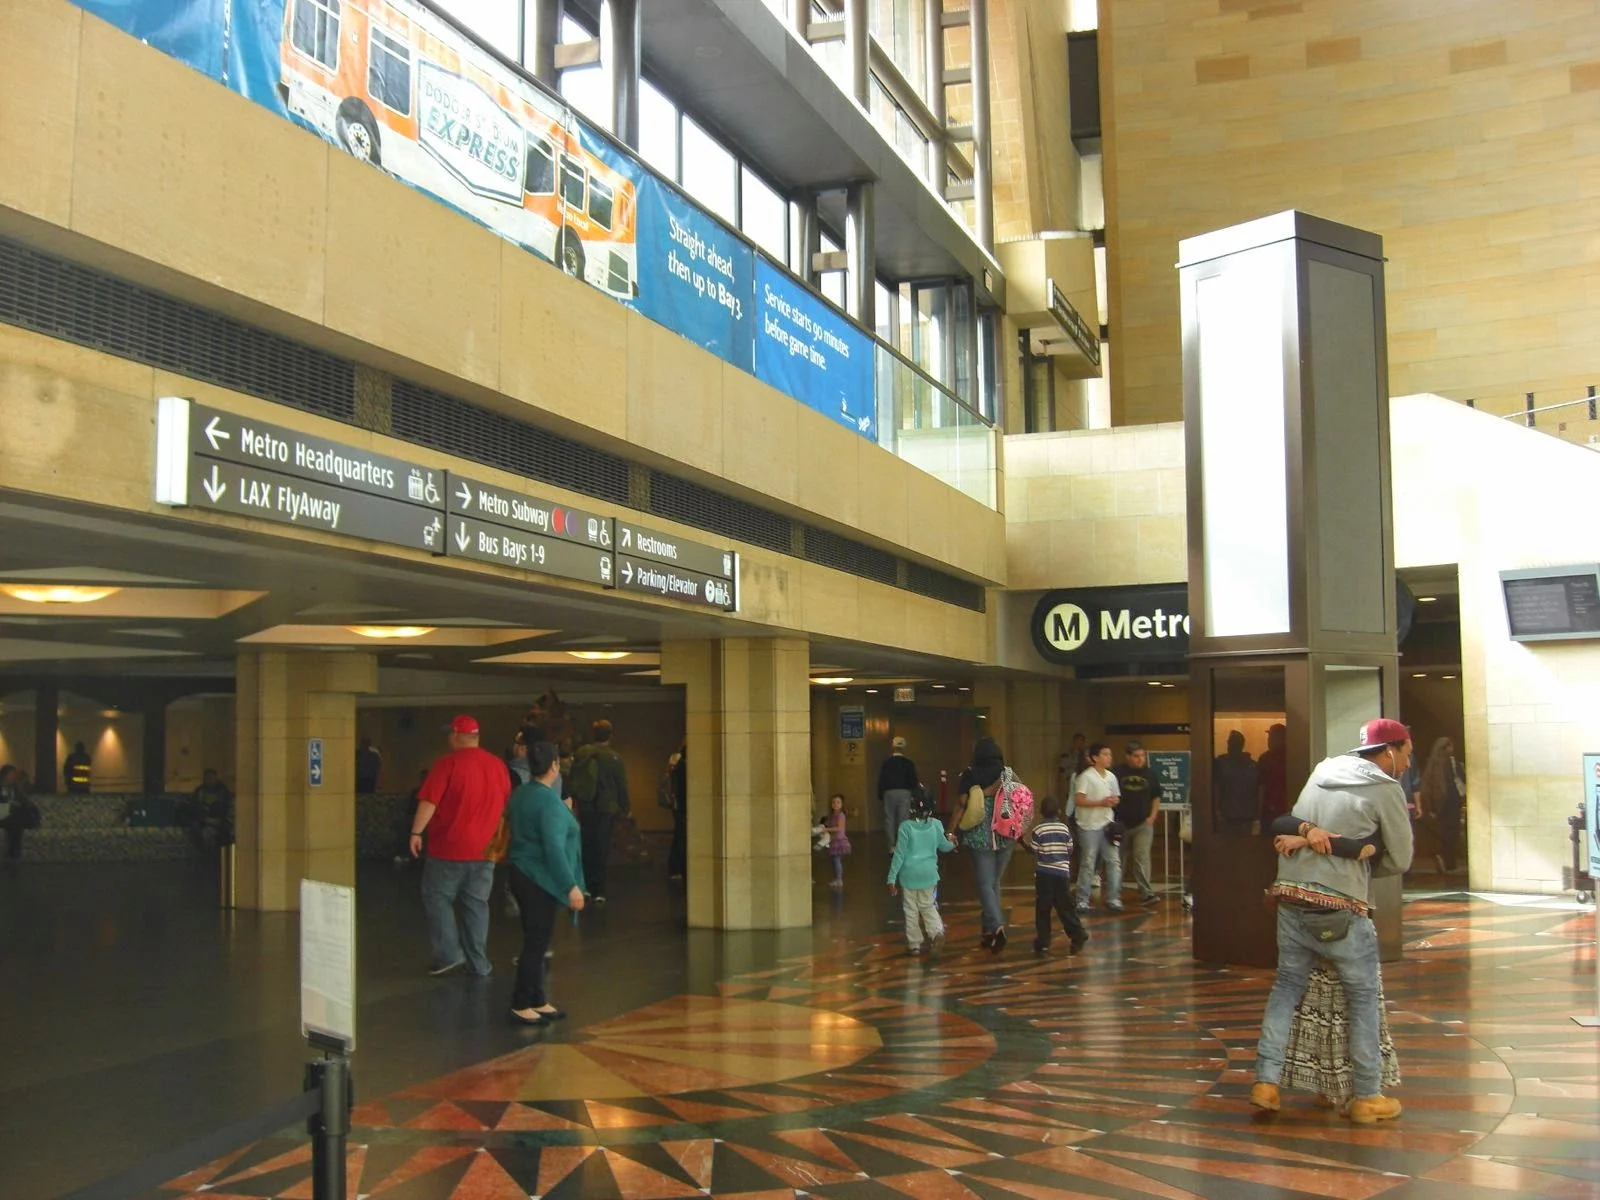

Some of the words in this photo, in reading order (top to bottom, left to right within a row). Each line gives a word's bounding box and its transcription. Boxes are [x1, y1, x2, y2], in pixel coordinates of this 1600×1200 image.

[427, 106, 520, 182] EXPRESS
[669, 215, 706, 261] Straight
[707, 243, 735, 284] ahead,
[668, 249, 691, 283] then
[693, 271, 705, 297] up
[706, 276, 717, 300] to
[718, 281, 735, 317] Bay
[765, 283, 791, 320] Service
[791, 306, 812, 333] starts
[812, 322, 823, 342] 90
[823, 329, 849, 358] minutes
[765, 311, 789, 347] before
[789, 335, 809, 359] game
[809, 344, 827, 371] time.
[241, 427, 288, 463] Metro
[295, 441, 395, 489] Headquarters
[240, 478, 271, 509] LAX
[278, 486, 341, 529] FlyAway
[479, 490, 509, 517] Metro
[512, 499, 549, 532] Subway
[479, 531, 499, 555] Bus
[503, 536, 528, 565] Bays
[530, 543, 545, 565] 1-9
[637, 533, 678, 560] Restrooms
[637, 567, 698, 596] Parking/Elevator
[1053, 613, 1080, 642] M
